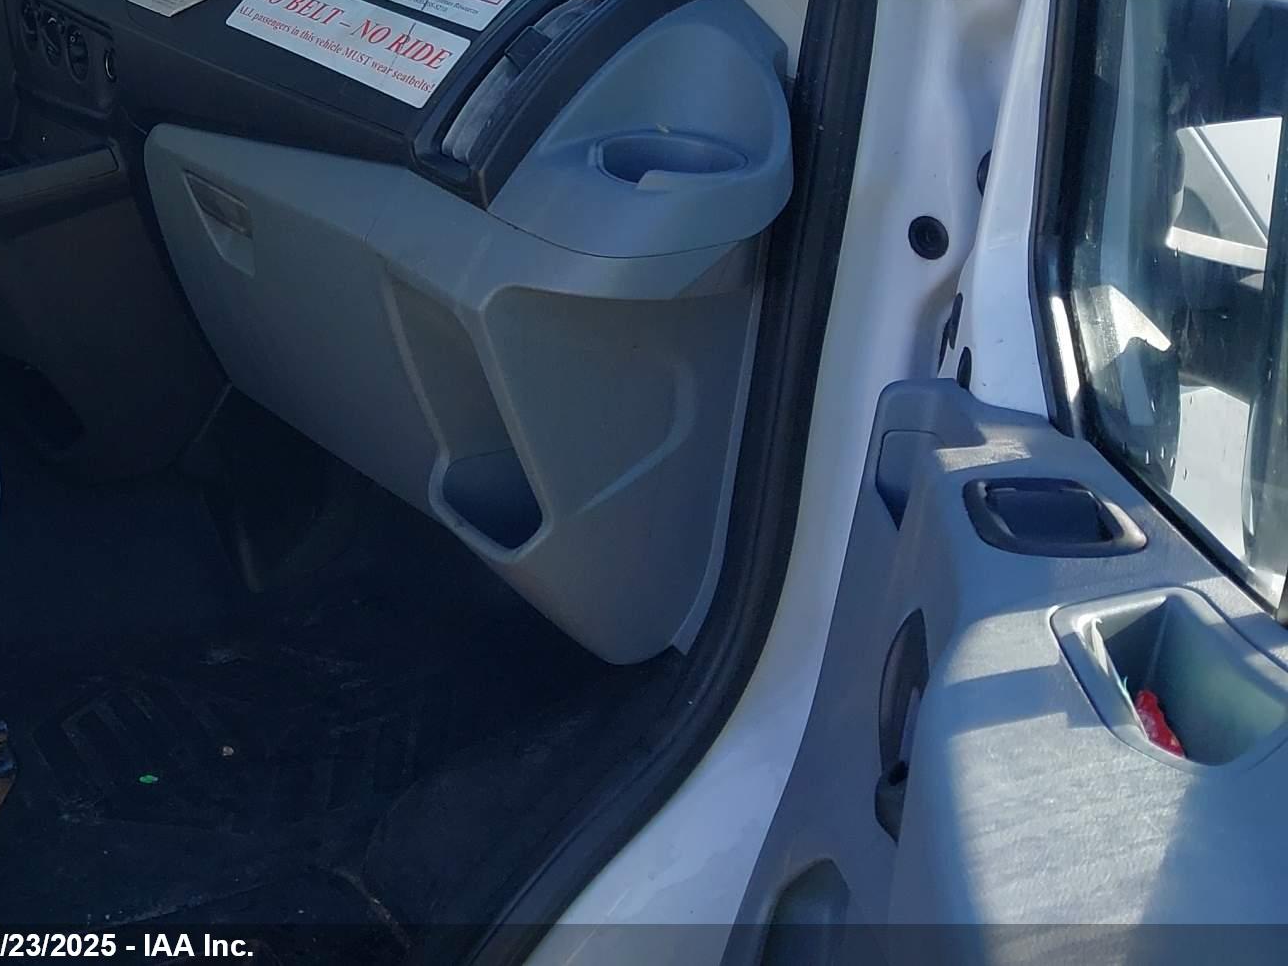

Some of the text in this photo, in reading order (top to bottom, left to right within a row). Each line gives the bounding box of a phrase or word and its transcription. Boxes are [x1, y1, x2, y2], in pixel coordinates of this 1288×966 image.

[238, 6, 436, 93] ALL passengers in this vehicle MUST wear seatbelts!
[350, 19, 391, 44] NO
[384, 32, 452, 70] RIDE
